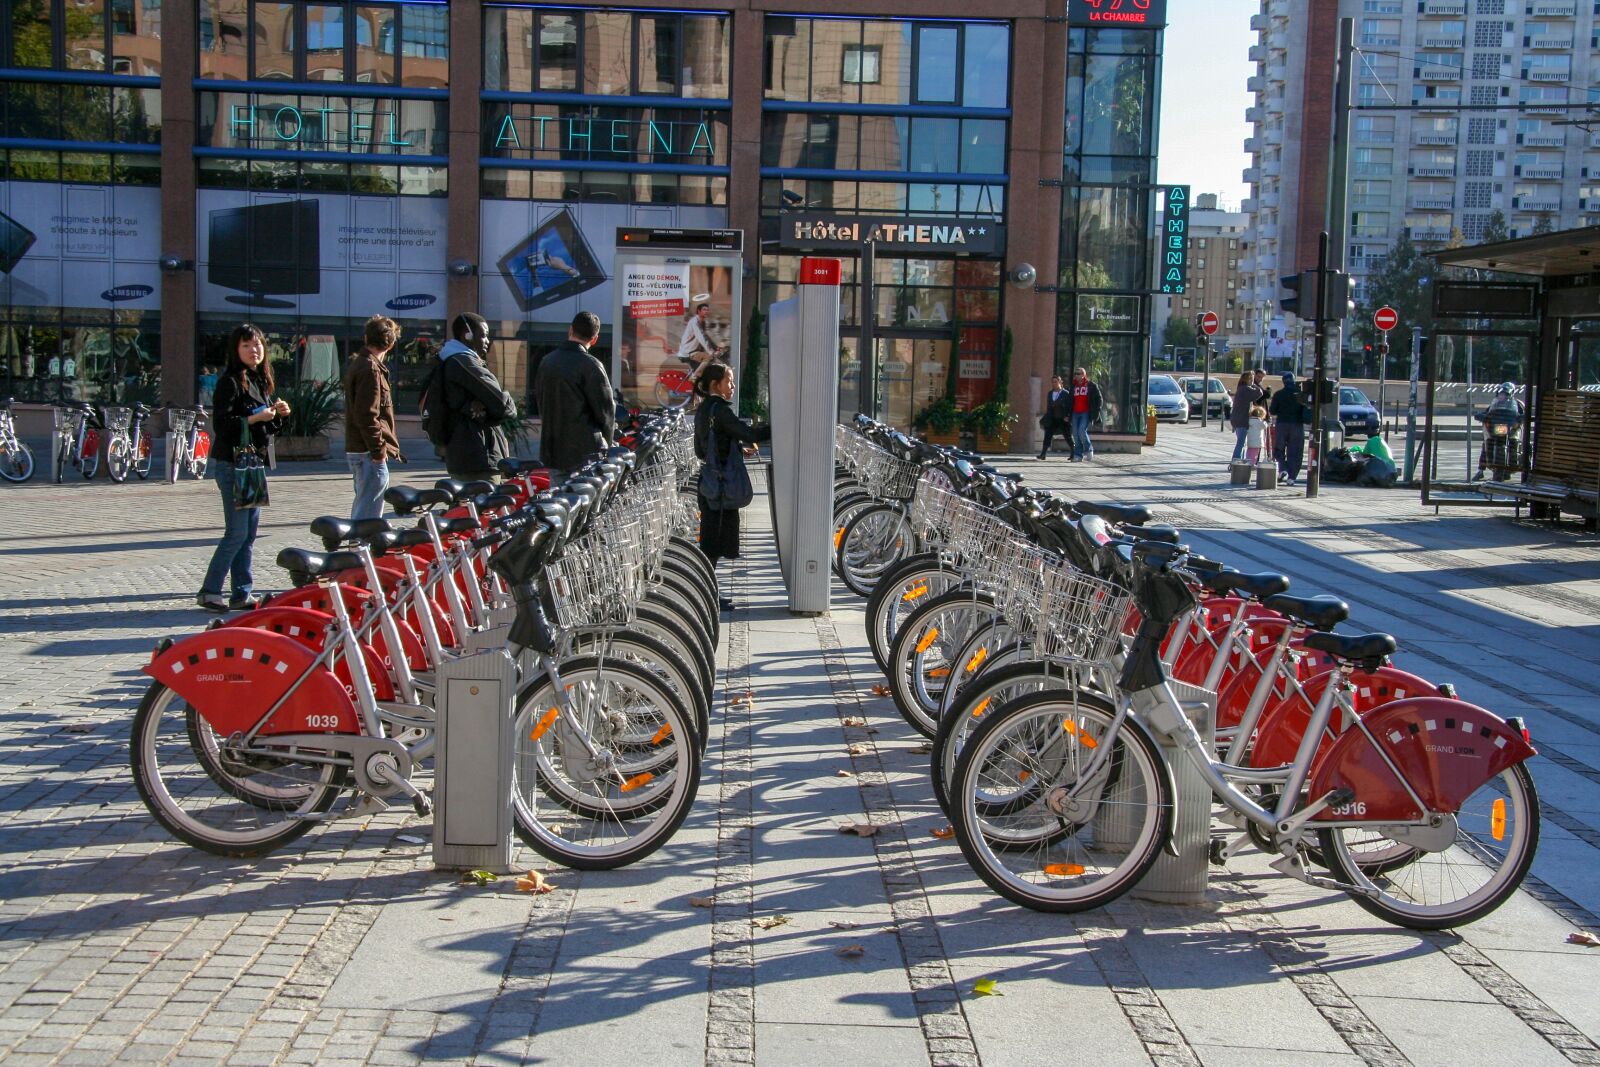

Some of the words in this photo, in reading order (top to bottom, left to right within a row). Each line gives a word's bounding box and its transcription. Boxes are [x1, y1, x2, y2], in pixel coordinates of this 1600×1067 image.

[1090, 12, 1100, 20] LA
[1102, 12, 1145, 22] CHAMBRE
[231, 105, 409, 145] HOTEL
[495, 115, 714, 155] ATHENA
[92, 216, 99, 224] le
[124, 217, 138, 226] qui
[795, 220, 859, 241] Hôtel
[866, 223, 966, 244] ATHENA
[1167, 187, 1185, 281] ATHENA
[107, 288, 148, 297] SAMSUNG
[392, 298, 431, 306] SAMSUNG
[305, 715, 338, 727] 1039
